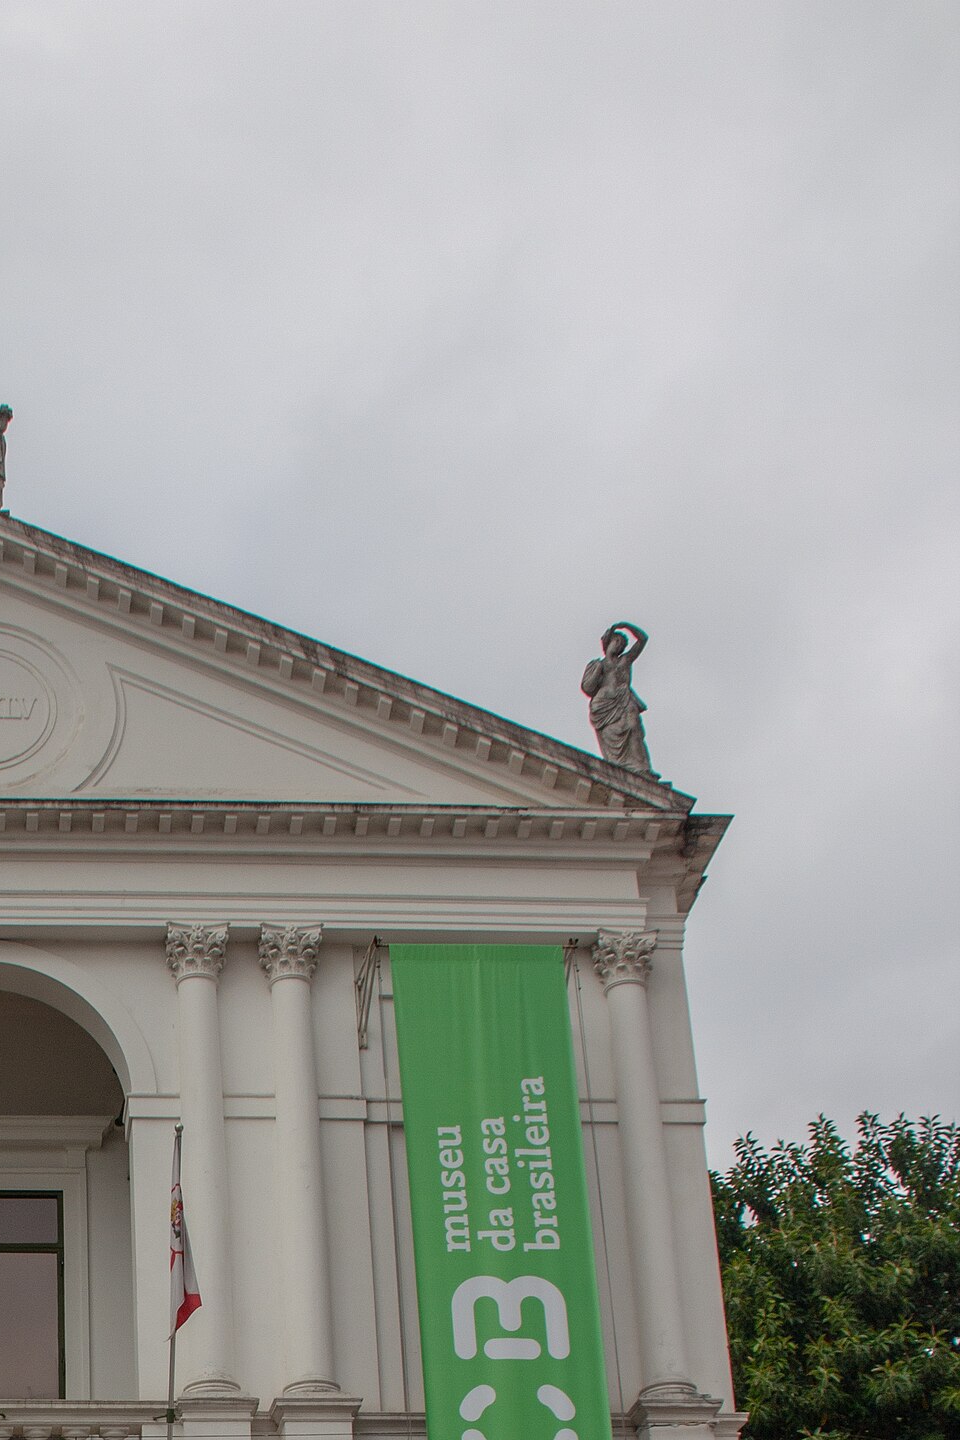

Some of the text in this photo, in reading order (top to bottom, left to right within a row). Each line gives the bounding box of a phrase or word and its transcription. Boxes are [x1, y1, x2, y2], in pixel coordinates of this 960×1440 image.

[437, 1125, 471, 1252] museu
[477, 1116, 516, 1252] da casa
[512, 1076, 561, 1252] brasileira
